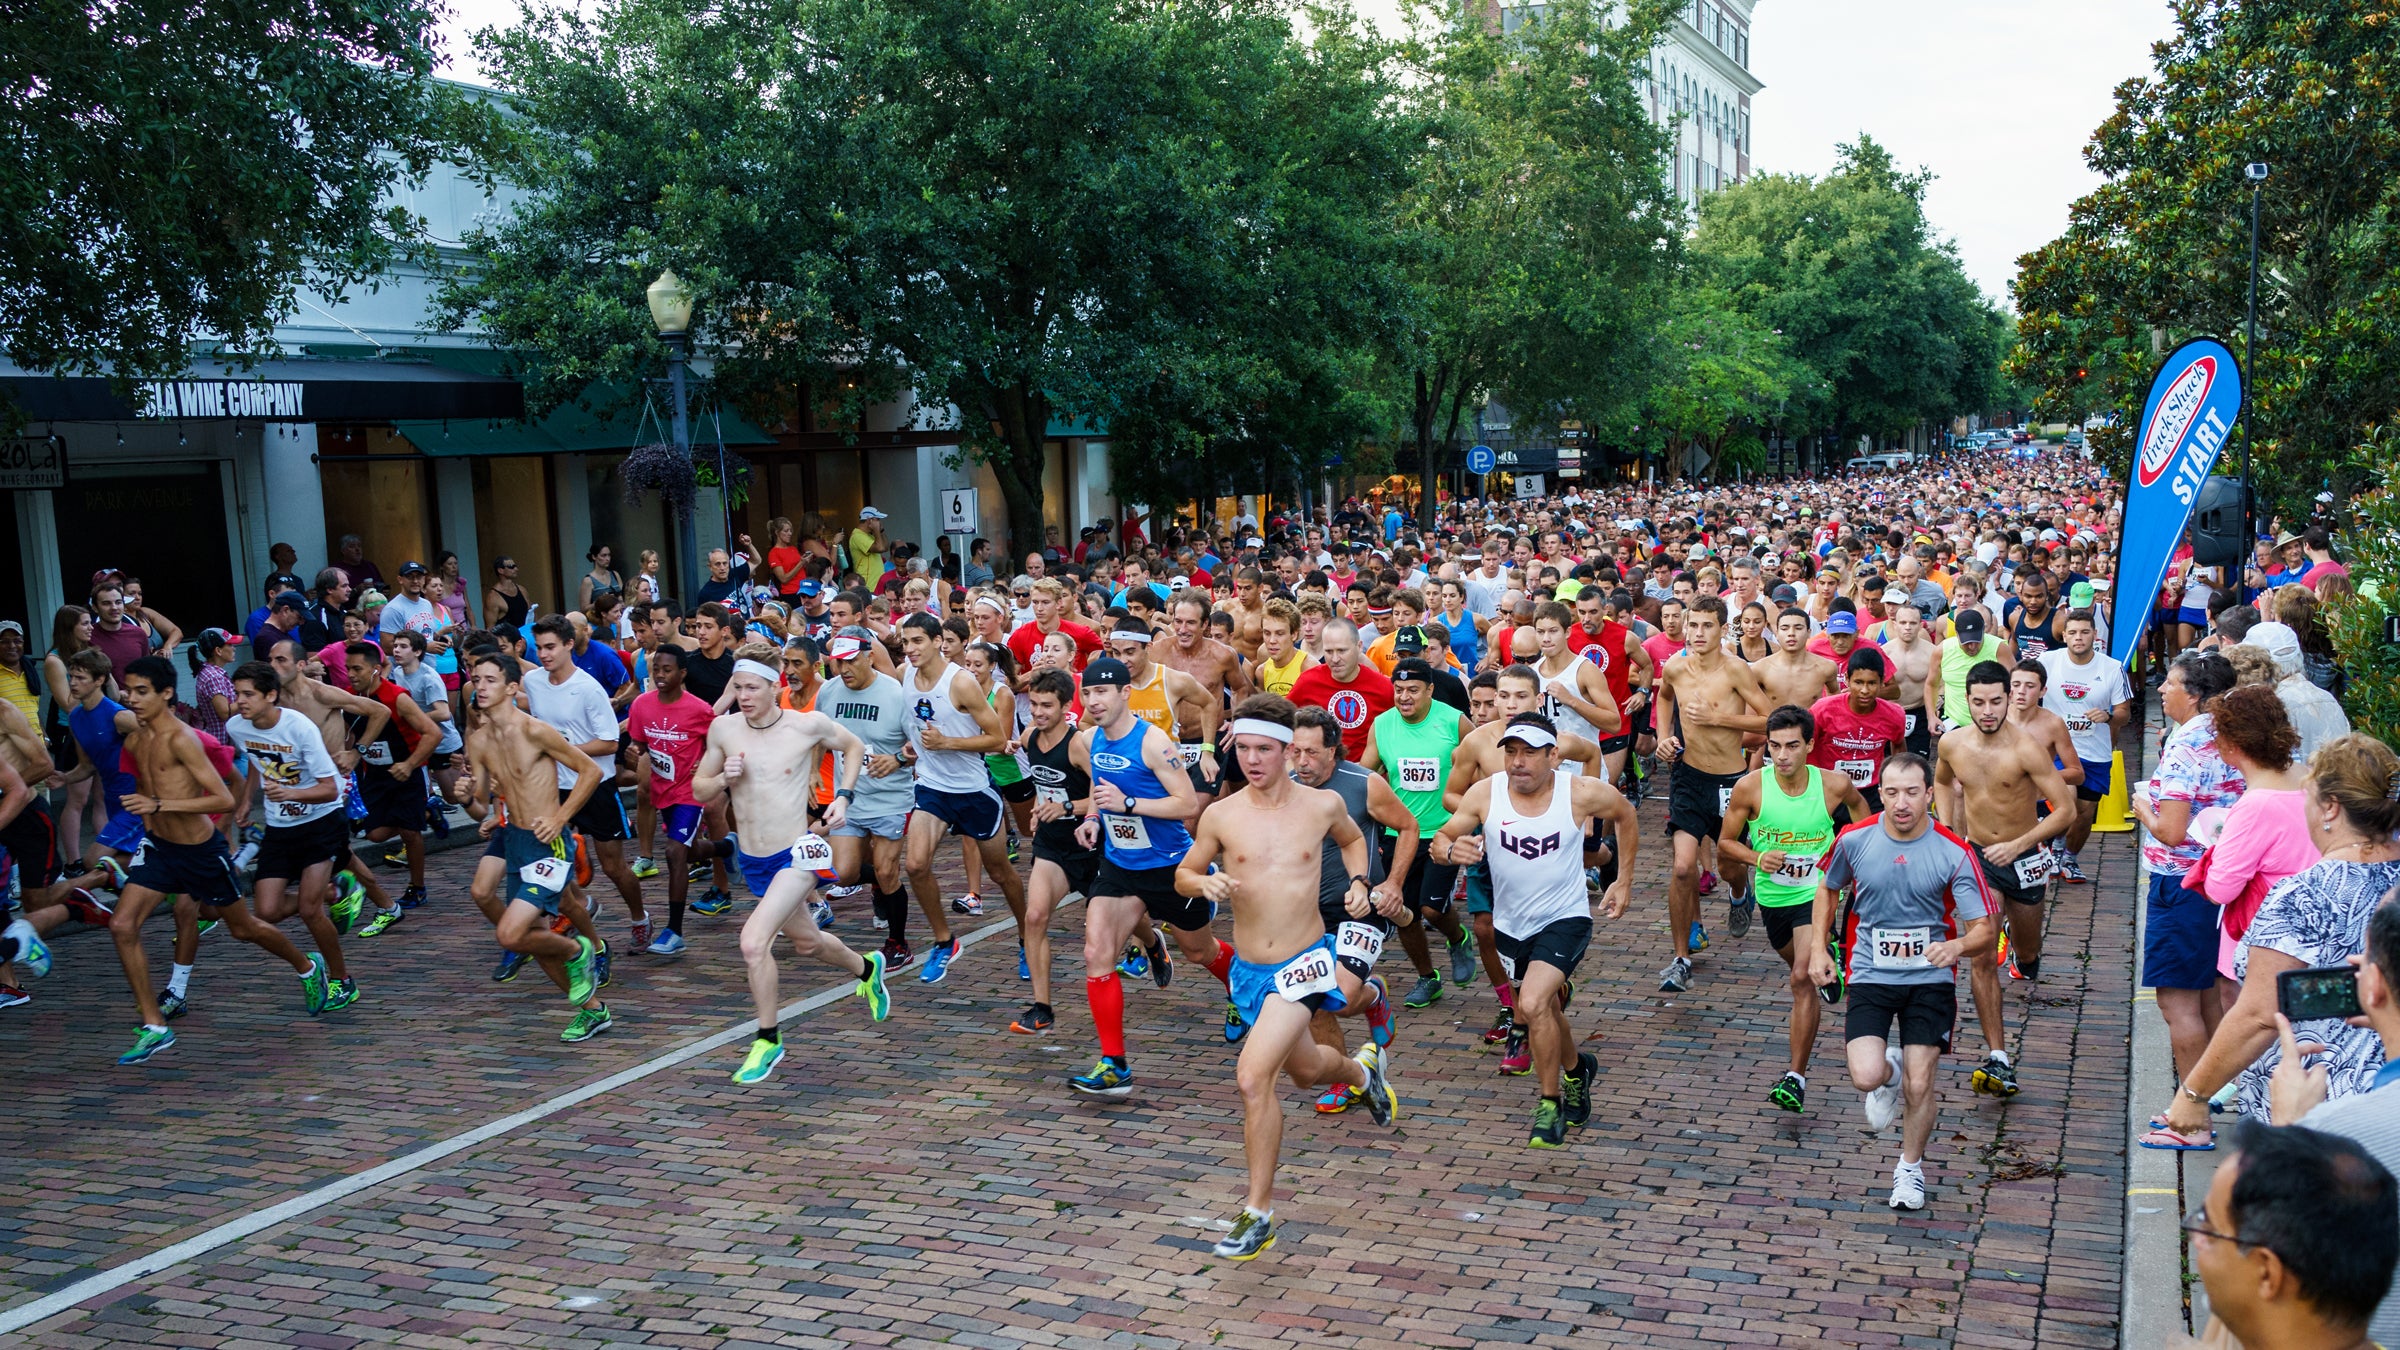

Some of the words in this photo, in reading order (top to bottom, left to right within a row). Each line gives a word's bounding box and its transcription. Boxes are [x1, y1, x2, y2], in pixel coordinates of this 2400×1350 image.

[178, 382, 226, 417] WINE
[227, 381, 304, 416] COMPANY
[2164, 395, 2198, 455] EVENTS
[1474, 451, 1488, 469] P
[2172, 406, 2227, 505] START
[1525, 478, 1533, 489] 8
[86, 490, 124, 511] PARK
[132, 488, 193, 510] AVENUE
[953, 494, 962, 515] 6
[835, 702, 879, 721] PUMA
[2066, 720, 2093, 731] 3072
[272, 744, 293, 754] STATE
[259, 759, 302, 780] XC
[1403, 768, 1435, 782] 3673
[279, 802, 309, 817] 2652
[1112, 825, 1139, 840] 582
[797, 843, 830, 860] 1683
[1500, 829, 1561, 861] USA
[535, 862, 554, 878] 97
[1776, 862, 1815, 878] 2417
[1343, 929, 1379, 955] 3716
[1879, 940, 1924, 958] 3715
[1282, 959, 1328, 989] 2340
